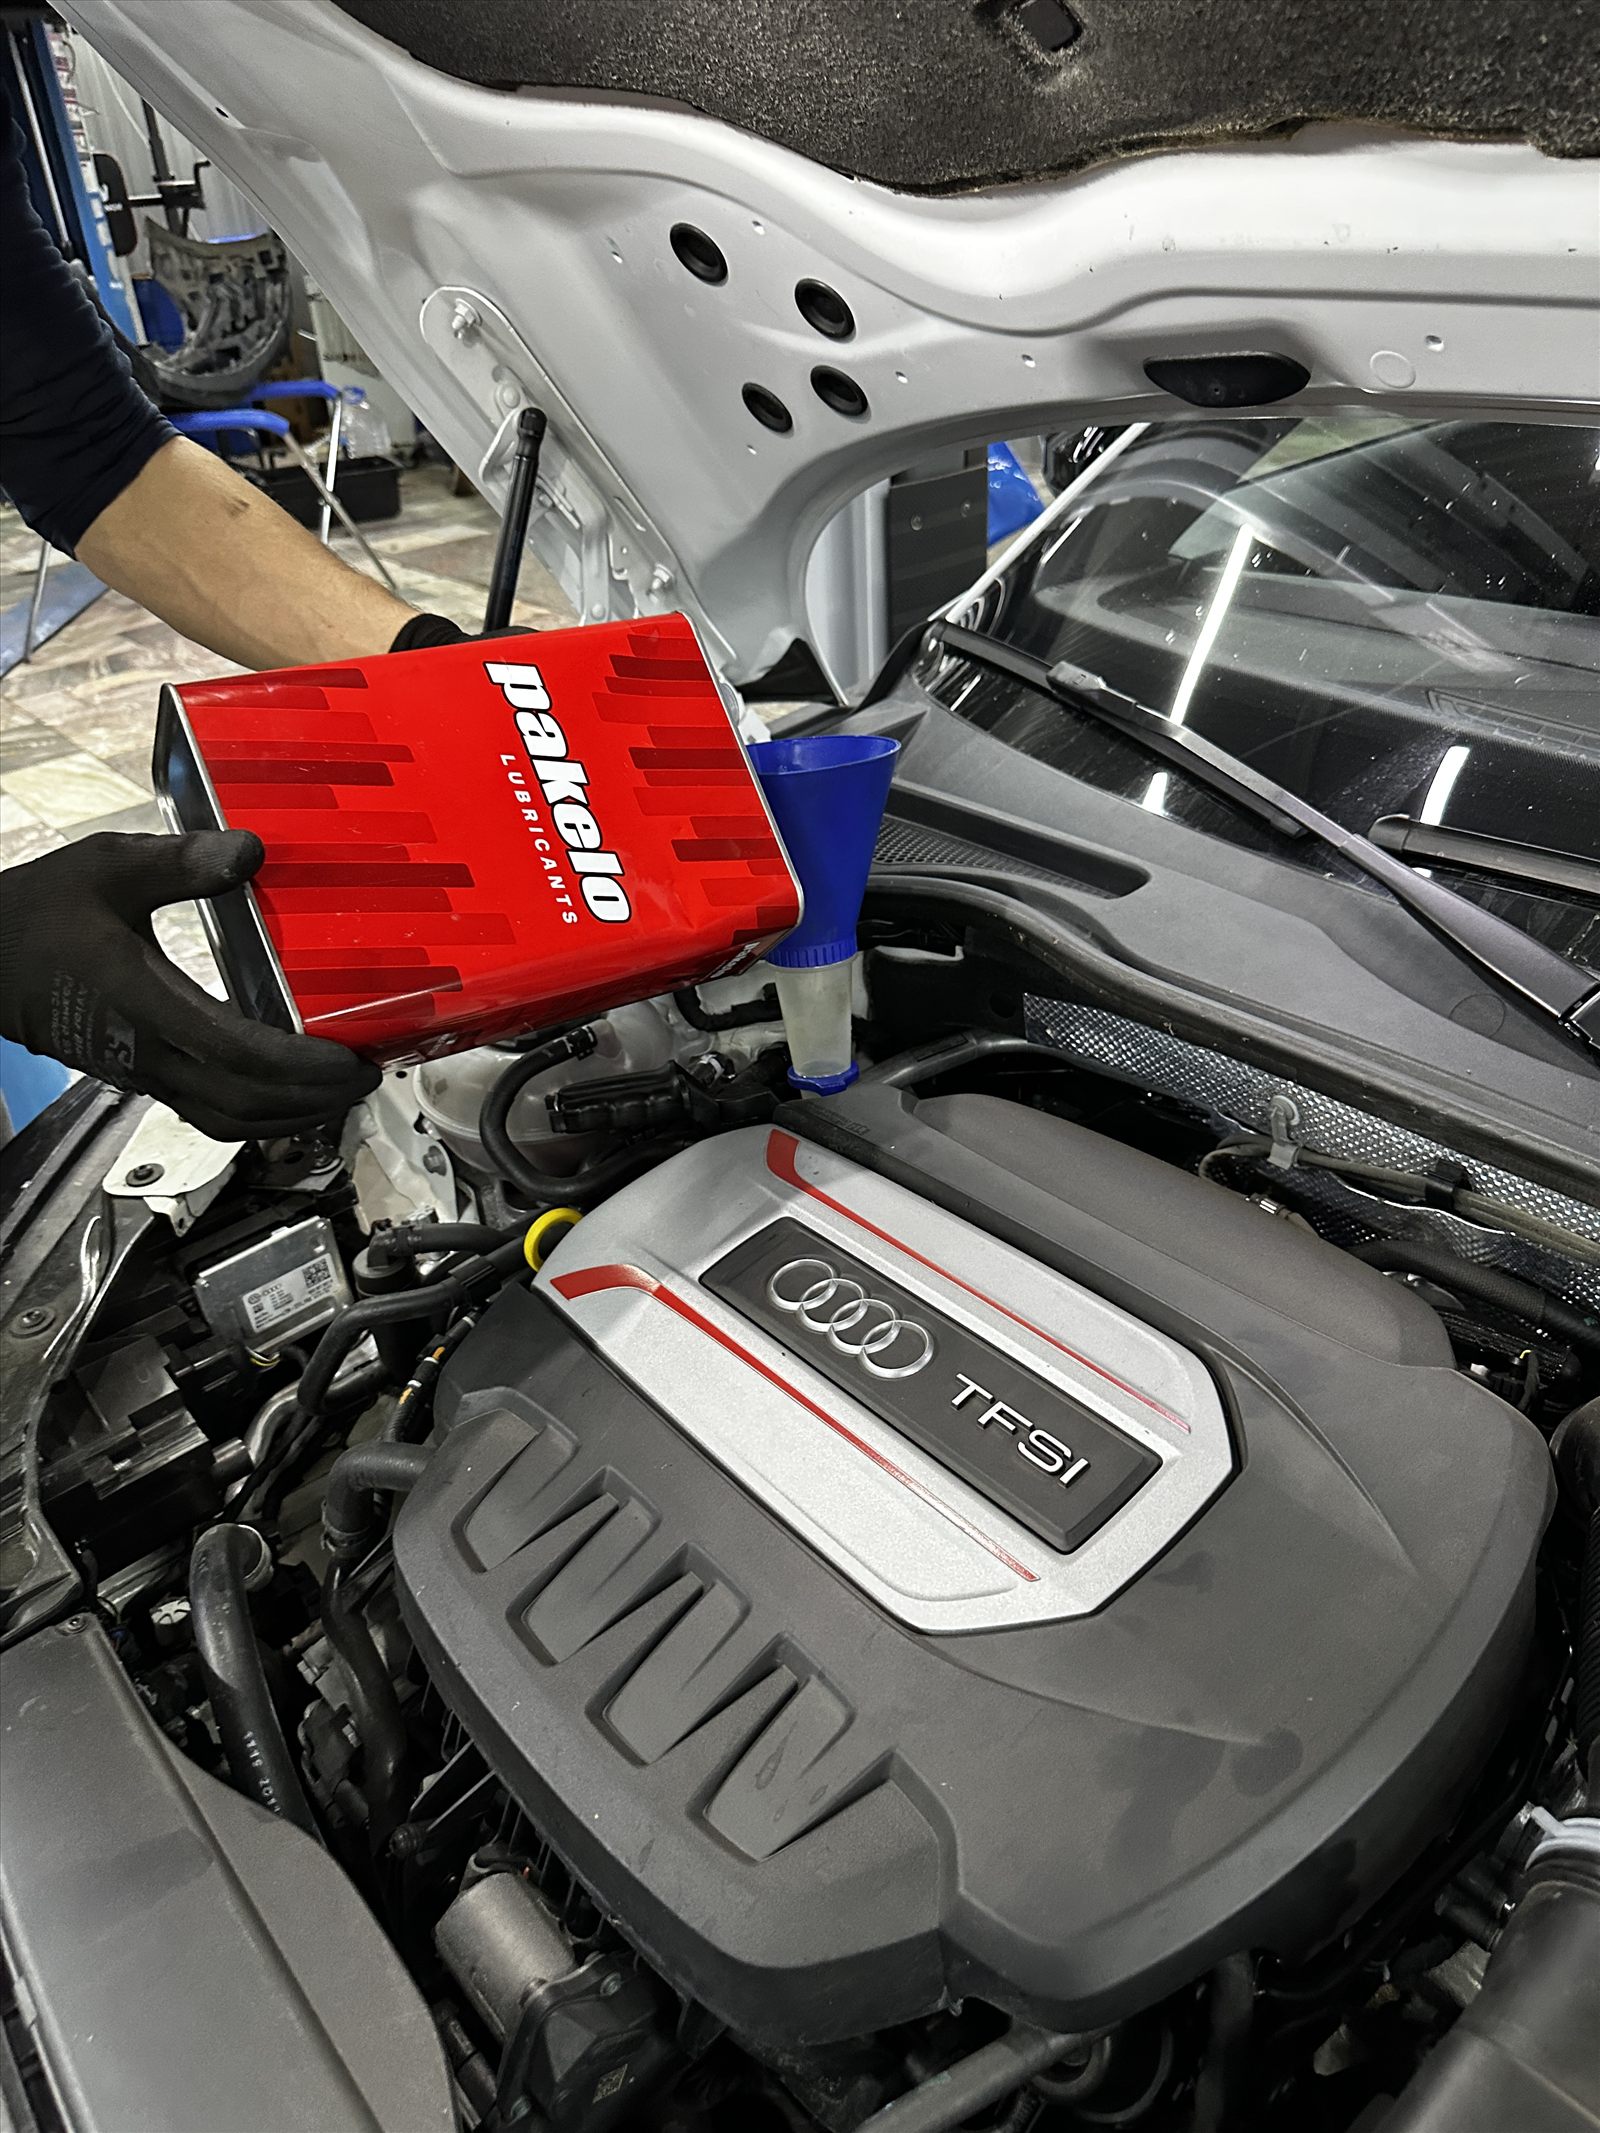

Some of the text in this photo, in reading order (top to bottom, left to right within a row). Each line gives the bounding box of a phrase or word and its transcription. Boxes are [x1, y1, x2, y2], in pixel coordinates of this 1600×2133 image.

[483, 661, 632, 923] pakelo
[500, 754, 578, 924] LUBRICANTS
[951, 1373, 1090, 1486] TFSI
